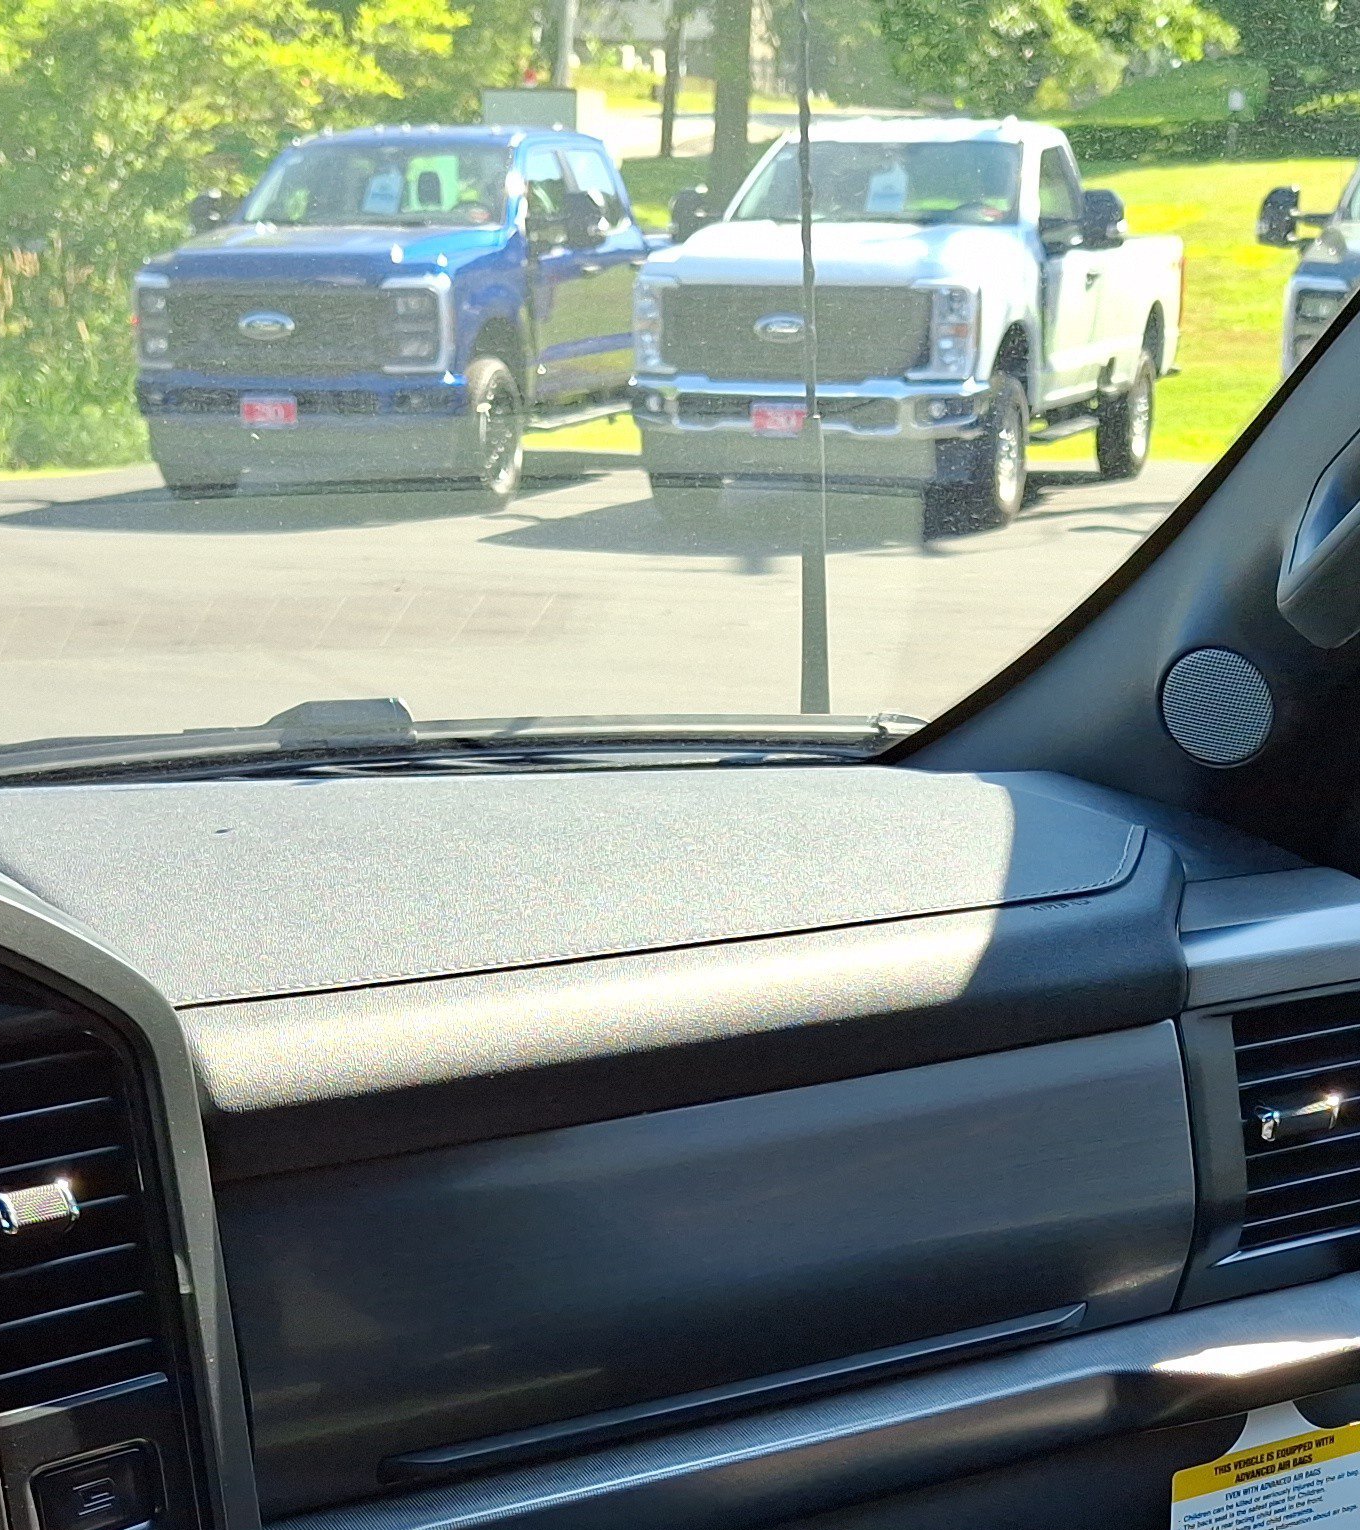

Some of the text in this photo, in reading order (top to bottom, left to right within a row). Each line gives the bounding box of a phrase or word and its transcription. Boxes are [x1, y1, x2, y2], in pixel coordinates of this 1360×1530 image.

[1214, 1434, 1335, 1476] THIS VEHICLE IS EQUIPPED WITH
[1234, 1453, 1313, 1483] ADVANCED AIR BAGS
